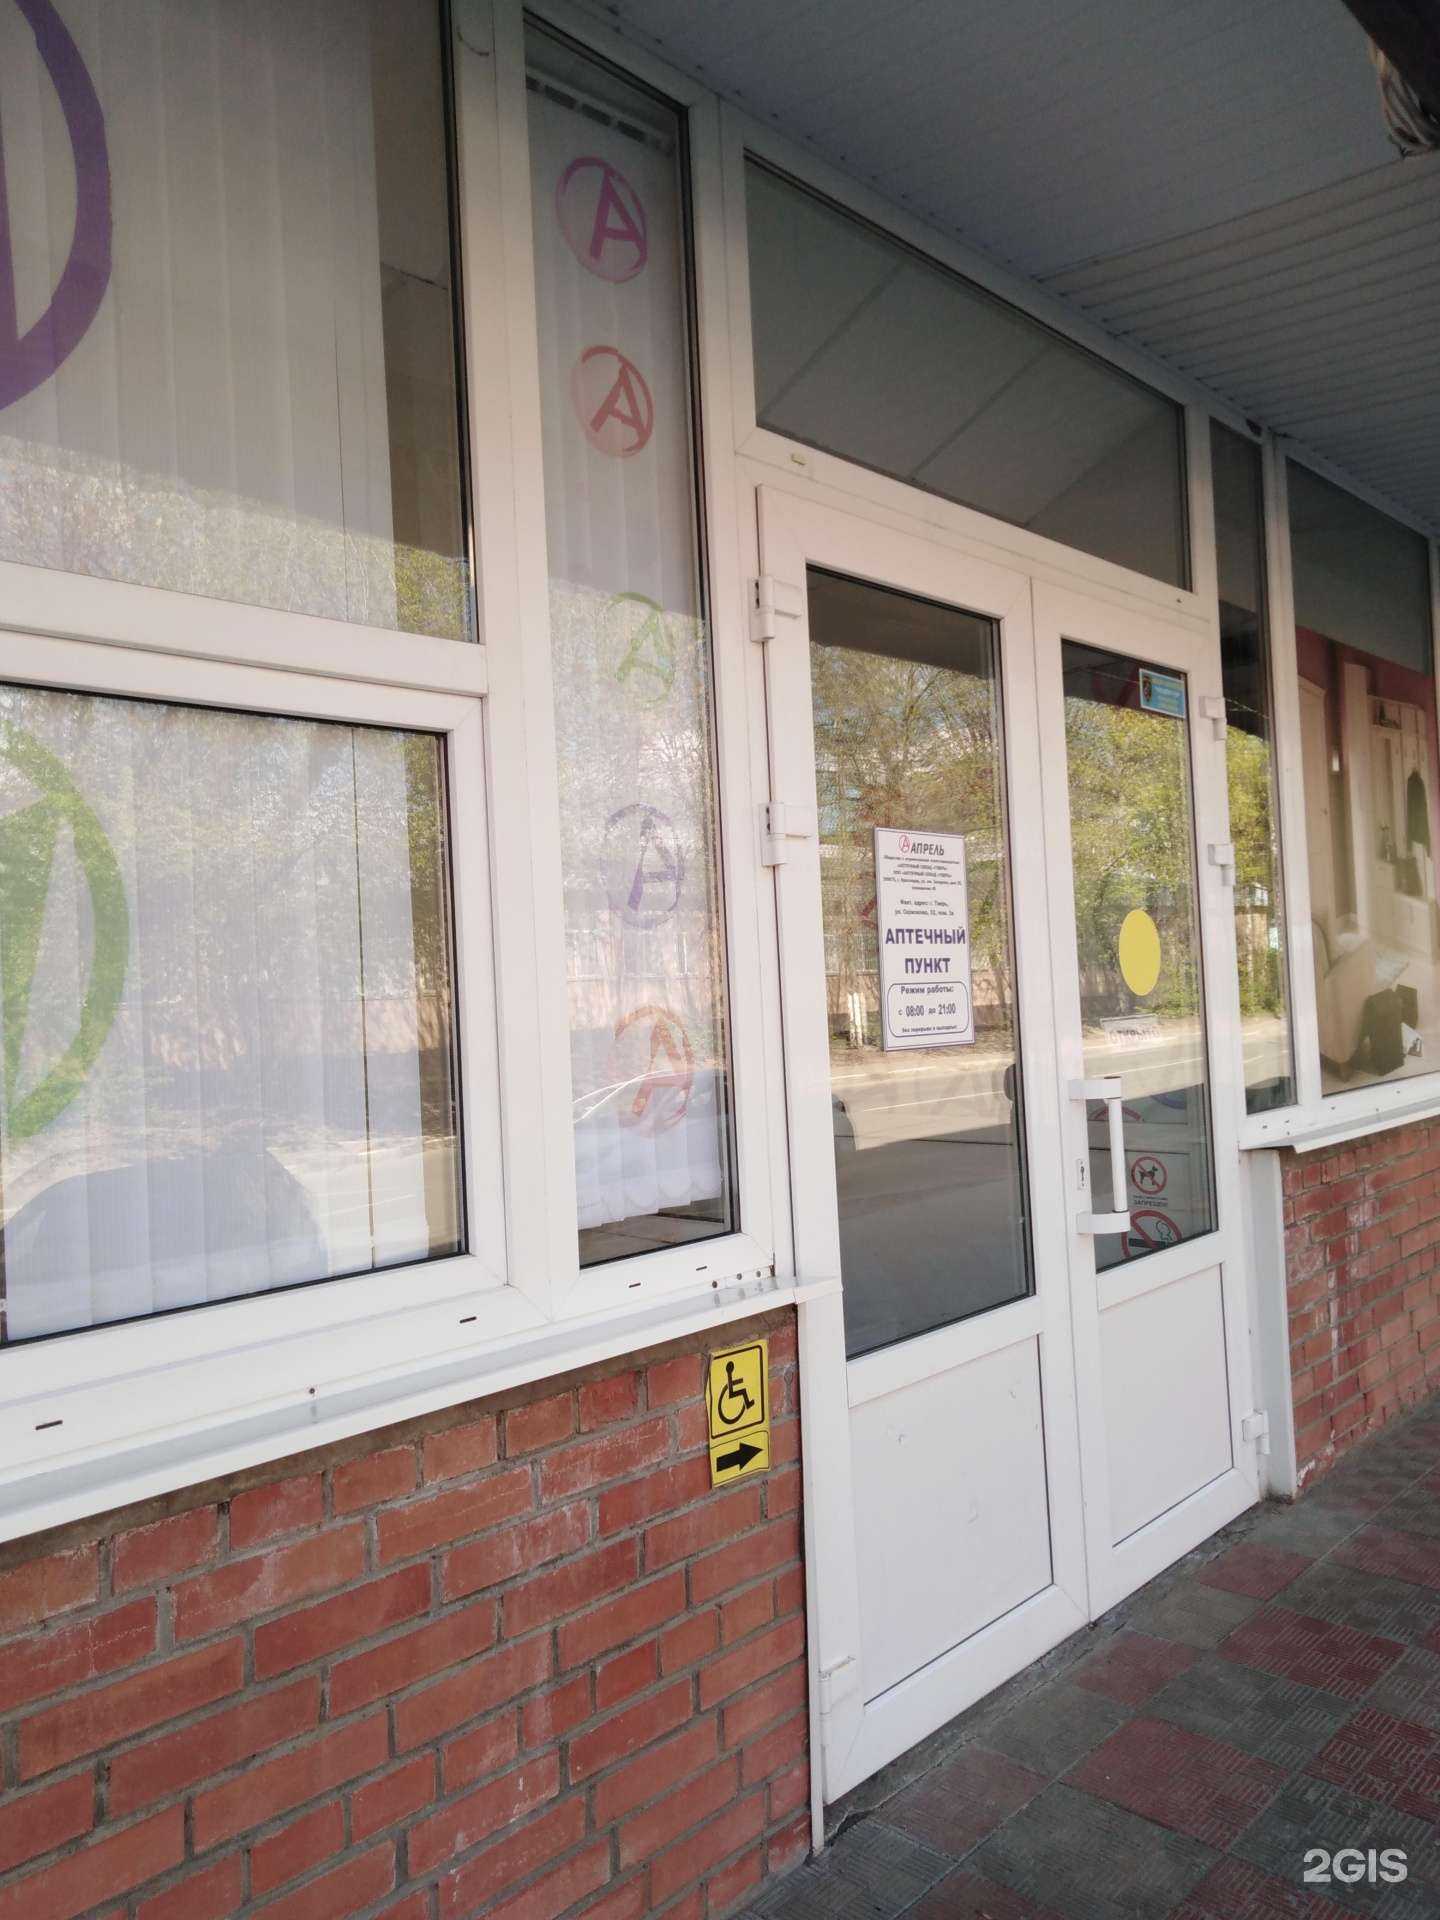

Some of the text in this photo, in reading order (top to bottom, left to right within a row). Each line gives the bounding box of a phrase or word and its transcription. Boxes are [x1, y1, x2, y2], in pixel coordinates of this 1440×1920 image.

[910, 842, 945, 856] АПРЕЛЬ
[885, 926, 966, 944] АПТЕЧНЫЙ
[904, 957, 951, 974] ПУНКТ
[900, 985, 954, 995] Режим работы:
[905, 1004, 925, 1017] 08:00
[938, 1003, 956, 1015] 21:00
